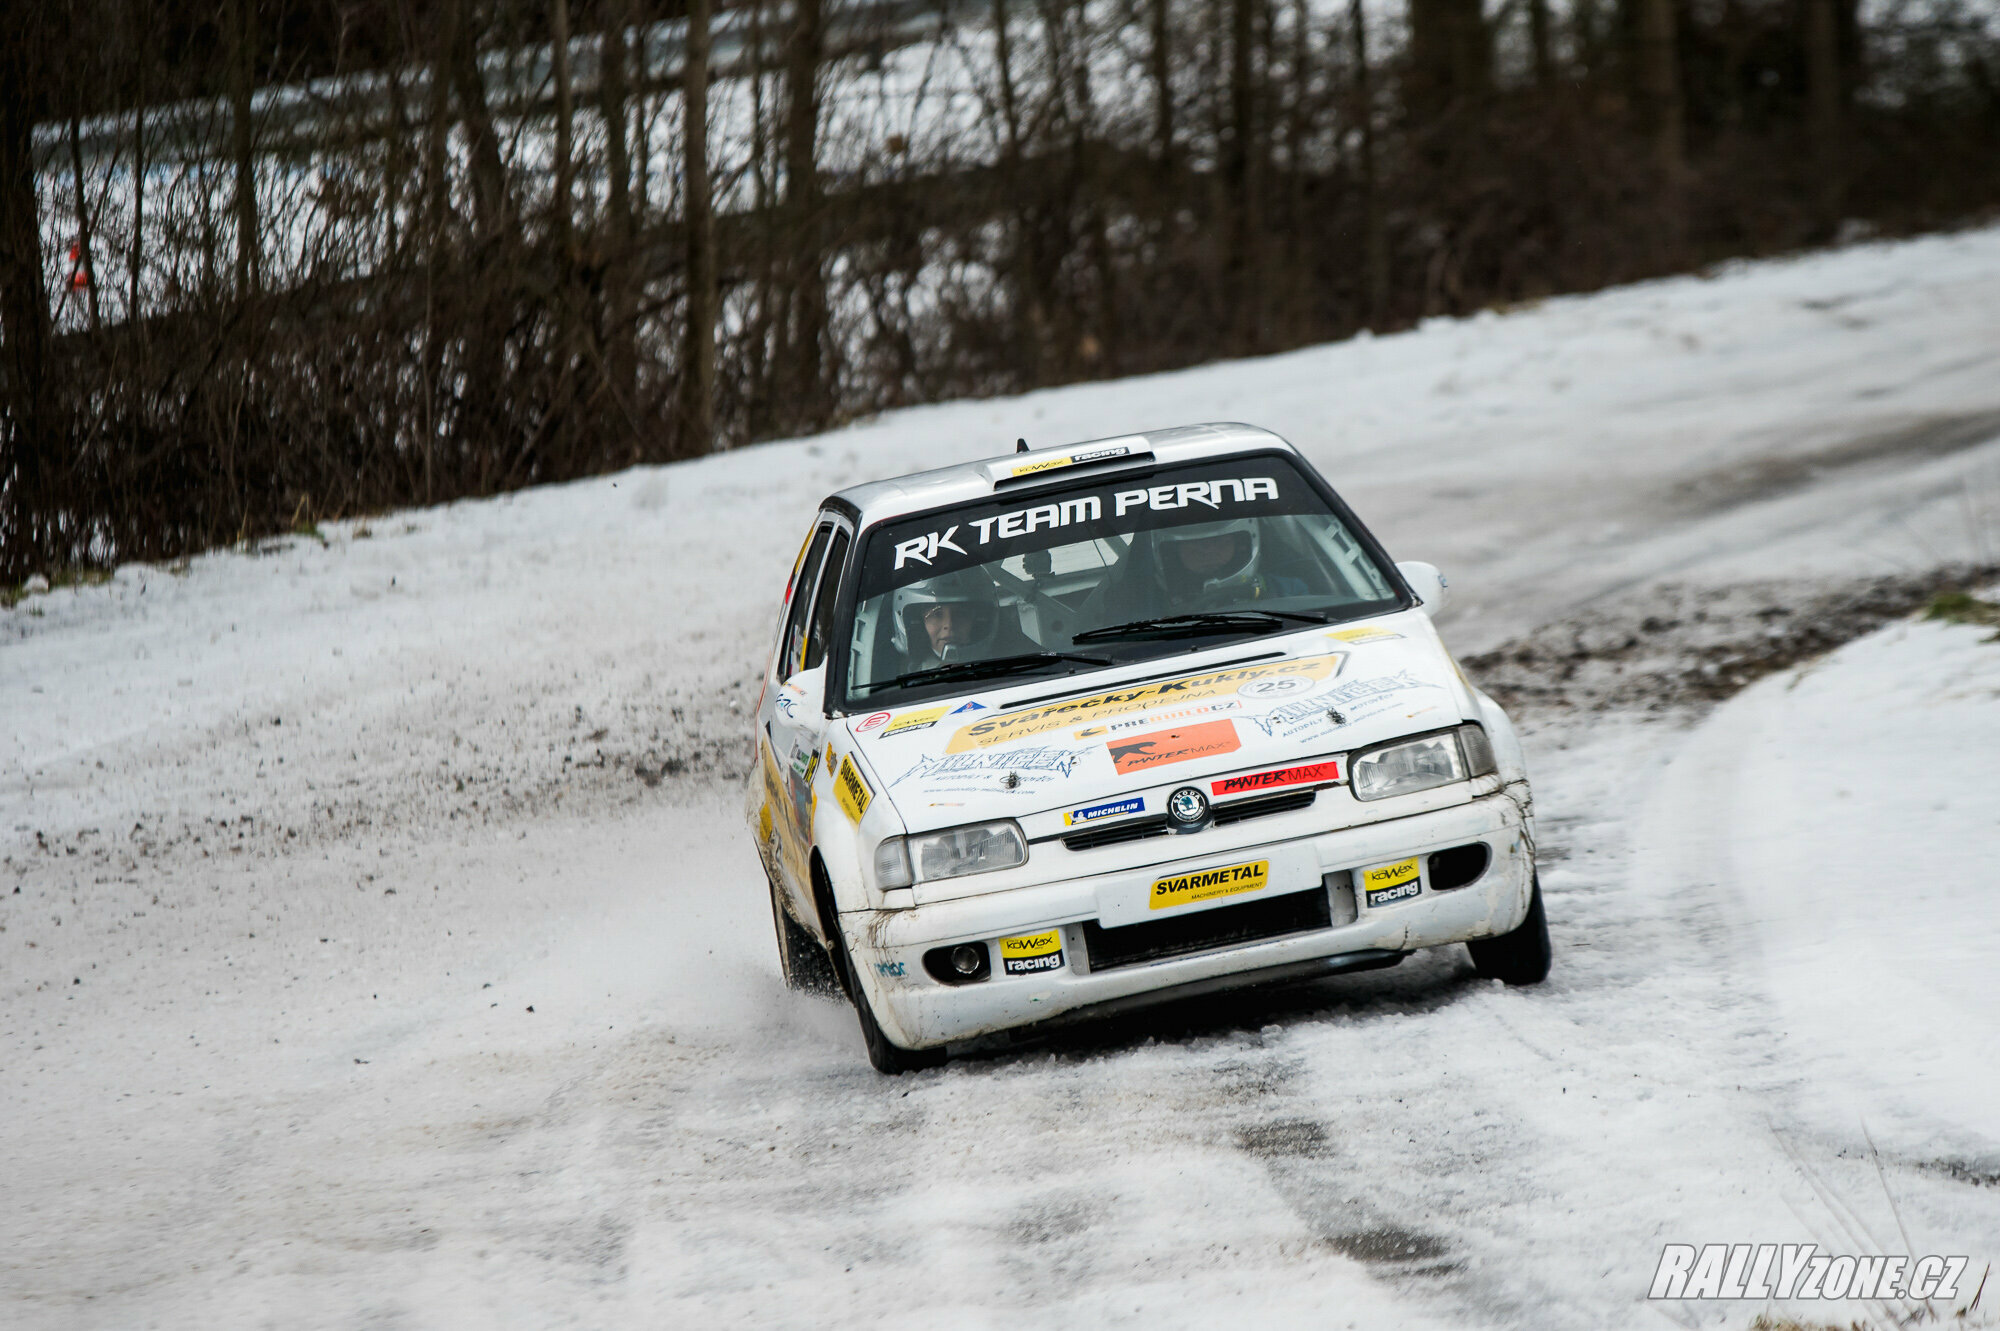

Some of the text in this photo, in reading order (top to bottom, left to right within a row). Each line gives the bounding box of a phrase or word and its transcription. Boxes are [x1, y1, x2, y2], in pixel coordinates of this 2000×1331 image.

[1074, 446, 1127, 462] racing
[893, 476, 1281, 571] RK TEAM PERNA
[1256, 679, 1297, 694] 25
[978, 720, 1060, 746] SERVIS
[841, 758, 868, 815] SVARMETAL
[1087, 801, 1139, 818] MICHELIN
[1155, 864, 1265, 896] SVARMETAL
[1191, 888, 1225, 900] MACHINERY
[1229, 881, 1264, 893] EQUIPMENT
[1369, 880, 1419, 905] racing
[1007, 954, 1061, 971] racing
